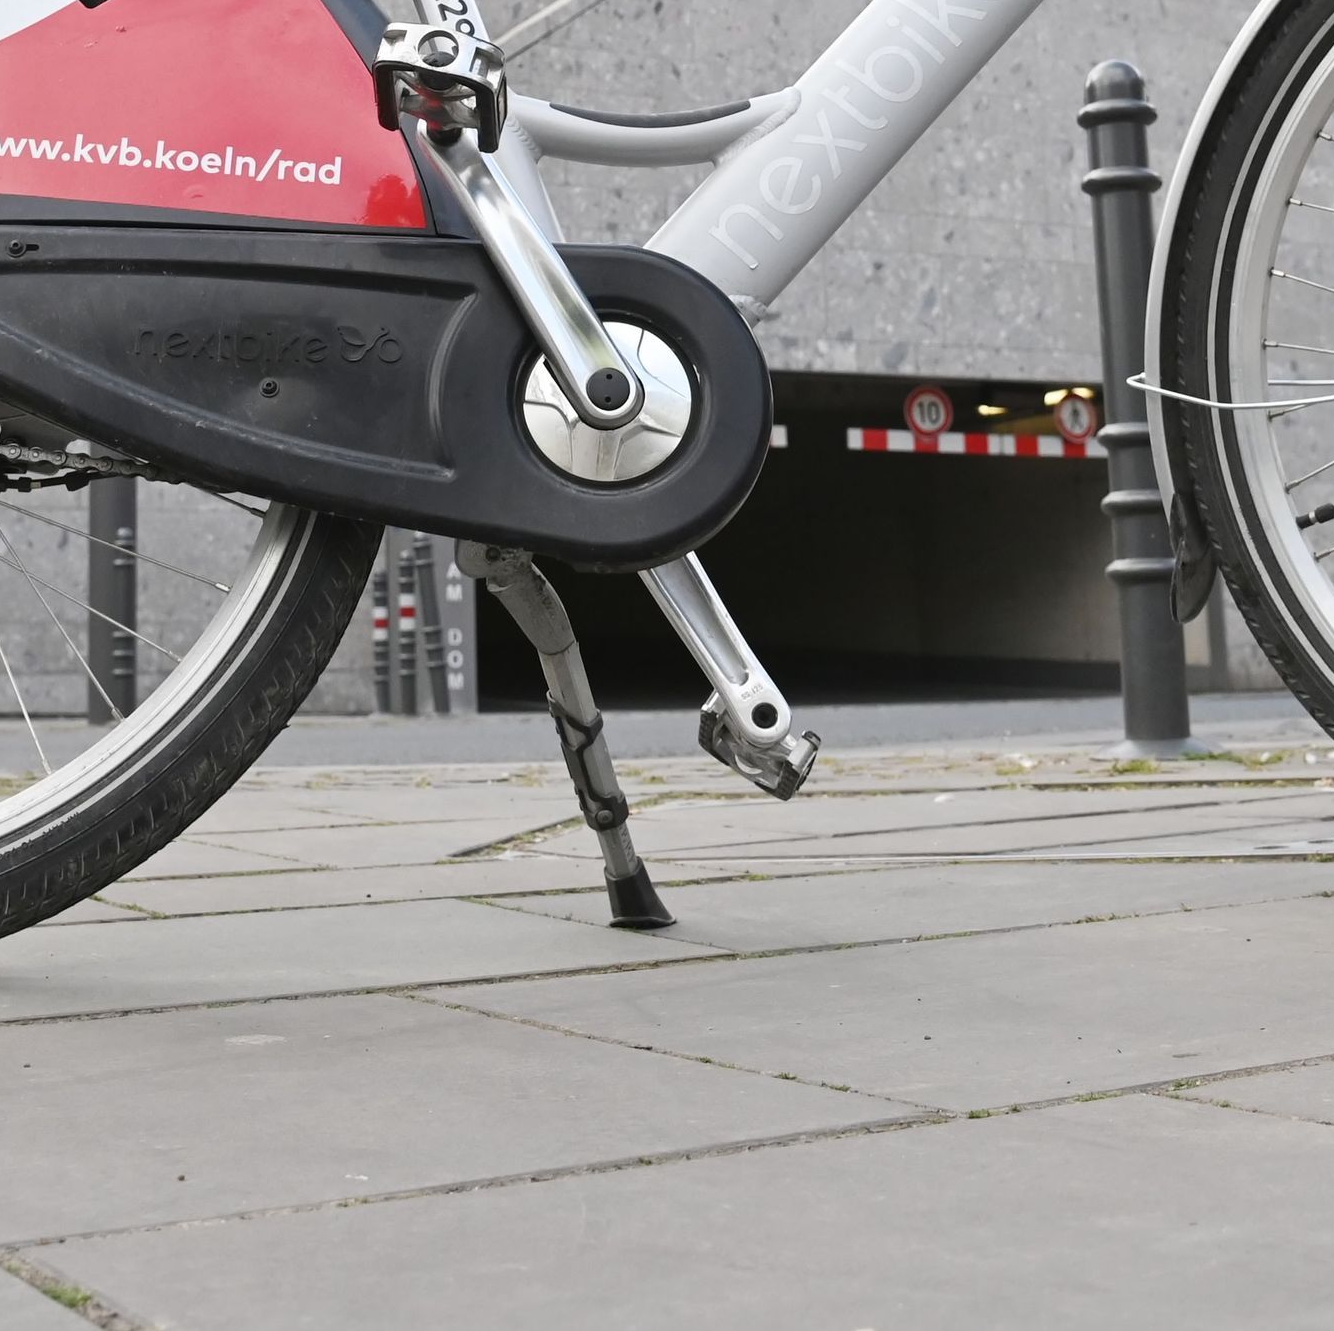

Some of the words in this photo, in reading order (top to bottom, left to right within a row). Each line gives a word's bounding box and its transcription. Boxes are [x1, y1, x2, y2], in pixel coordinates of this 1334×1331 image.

[134, 329, 329, 364] nextbike
[918, 401, 942, 425] 10
[447, 628, 465, 691] DOM
